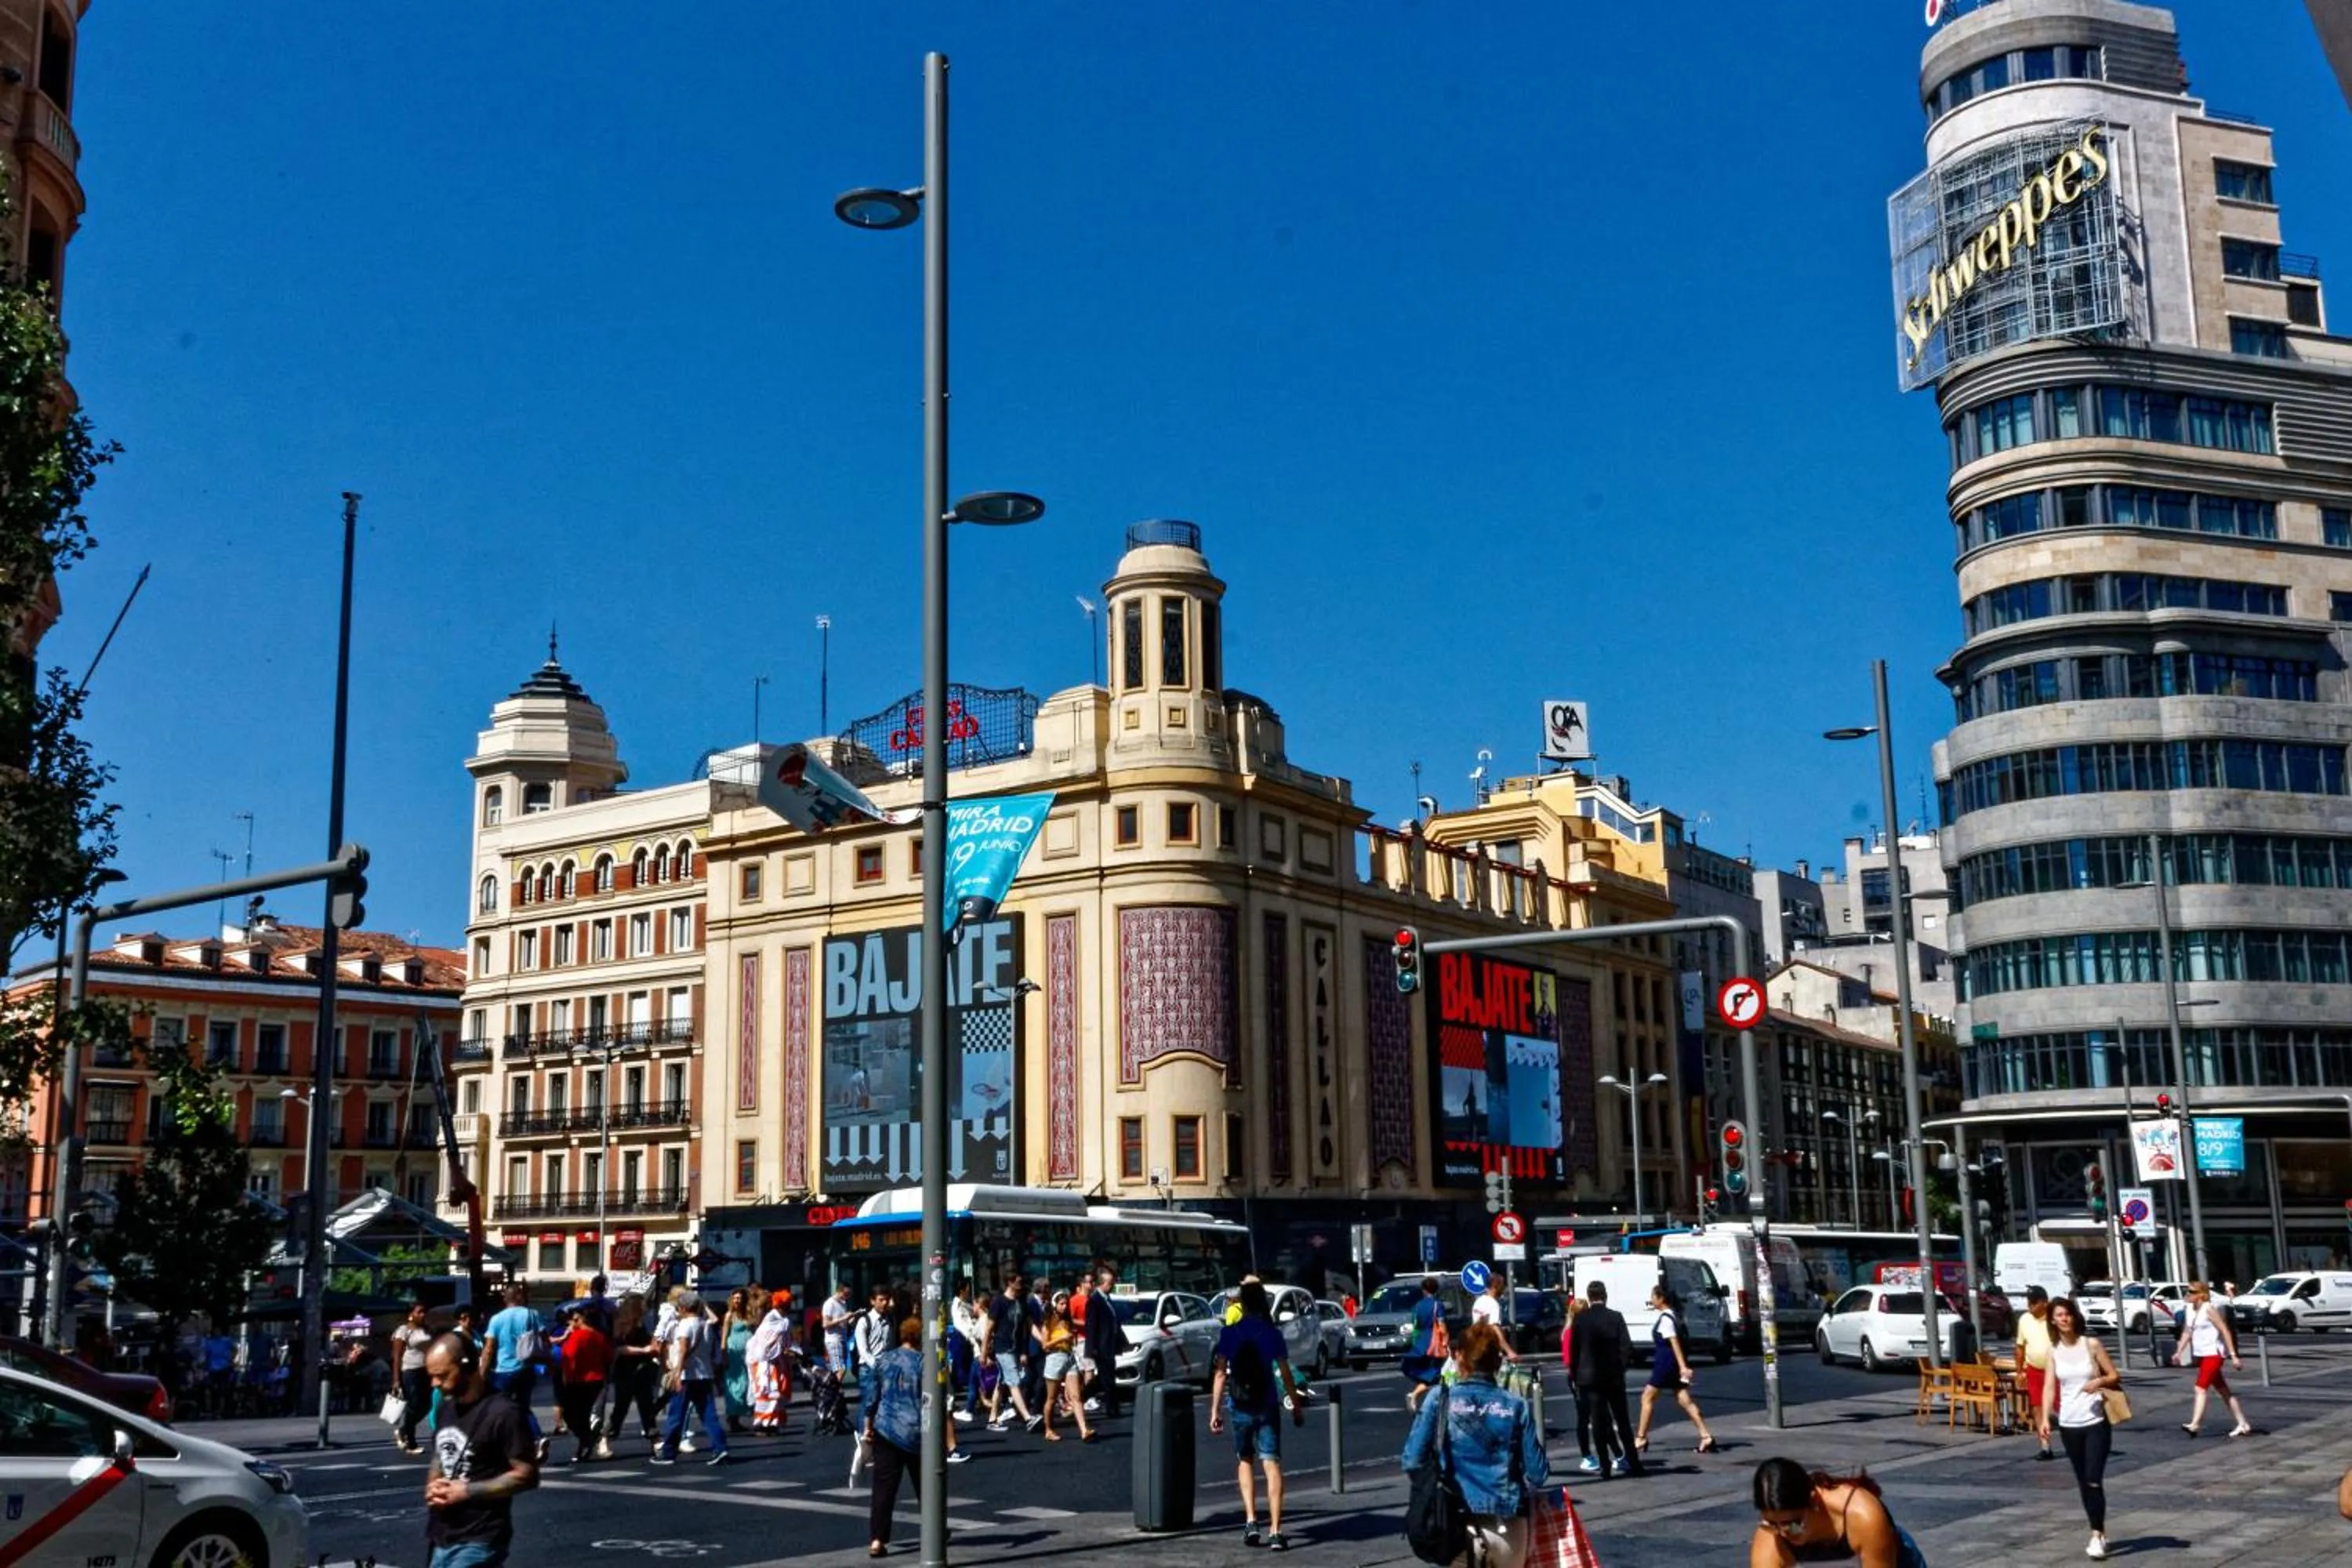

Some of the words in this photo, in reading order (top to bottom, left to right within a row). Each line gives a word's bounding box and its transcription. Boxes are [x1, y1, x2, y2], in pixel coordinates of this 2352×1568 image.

[1904, 125, 2107, 371] Schweppes
[950, 804, 1000, 822] MIRA
[826, 920, 1011, 1018] BÁJTE
[2198, 1142, 2224, 1156] 8/9
